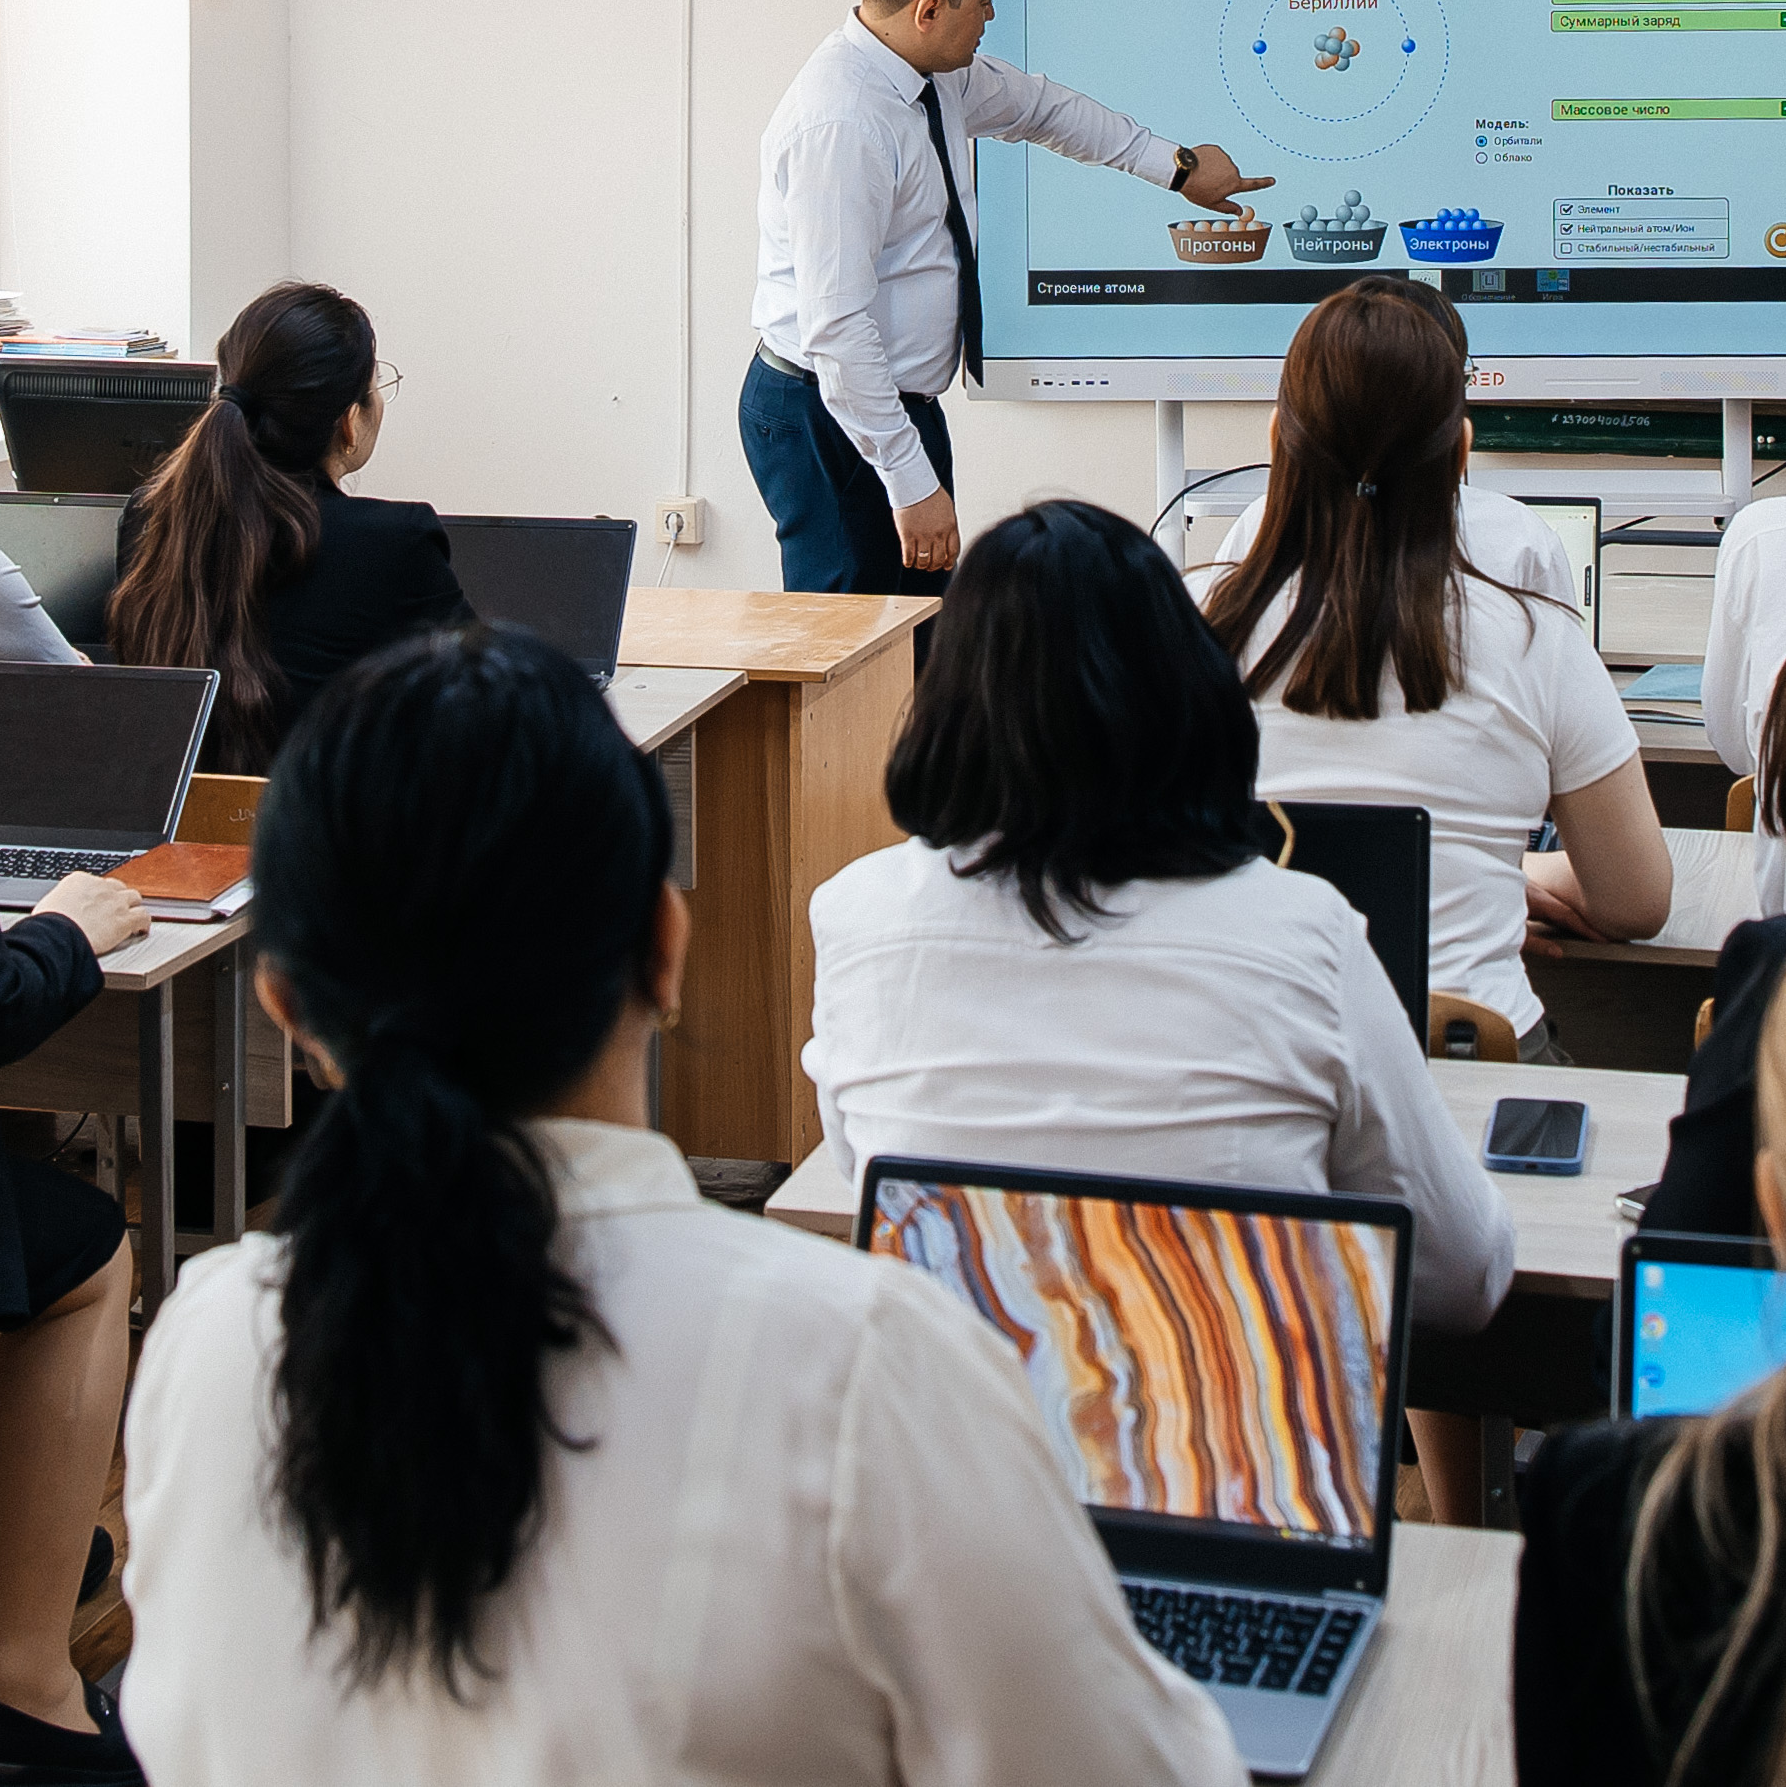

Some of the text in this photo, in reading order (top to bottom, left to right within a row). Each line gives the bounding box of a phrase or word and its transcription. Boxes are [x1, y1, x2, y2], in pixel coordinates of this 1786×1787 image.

[1560, 13, 1681, 28] Суммарный заряд
[1560, 104, 1670, 116] Массовое число
[1475, 119, 1530, 131] Модель:
[1494, 136, 1543, 147] Орбитали
[1494, 152, 1533, 163] Облако
[1608, 184, 1674, 196] Показать
[1577, 205, 1621, 214] Элемент
[1577, 224, 1695, 235] Нейтральный атом/Ион
[1179, 238, 1256, 255] Протоны
[1293, 237, 1374, 253] Нейтроны
[1409, 237, 1490, 253] Электроны
[1577, 243, 1715, 253] Стабильный/нестабильный
[1037, 282, 1145, 296] Строение атома
